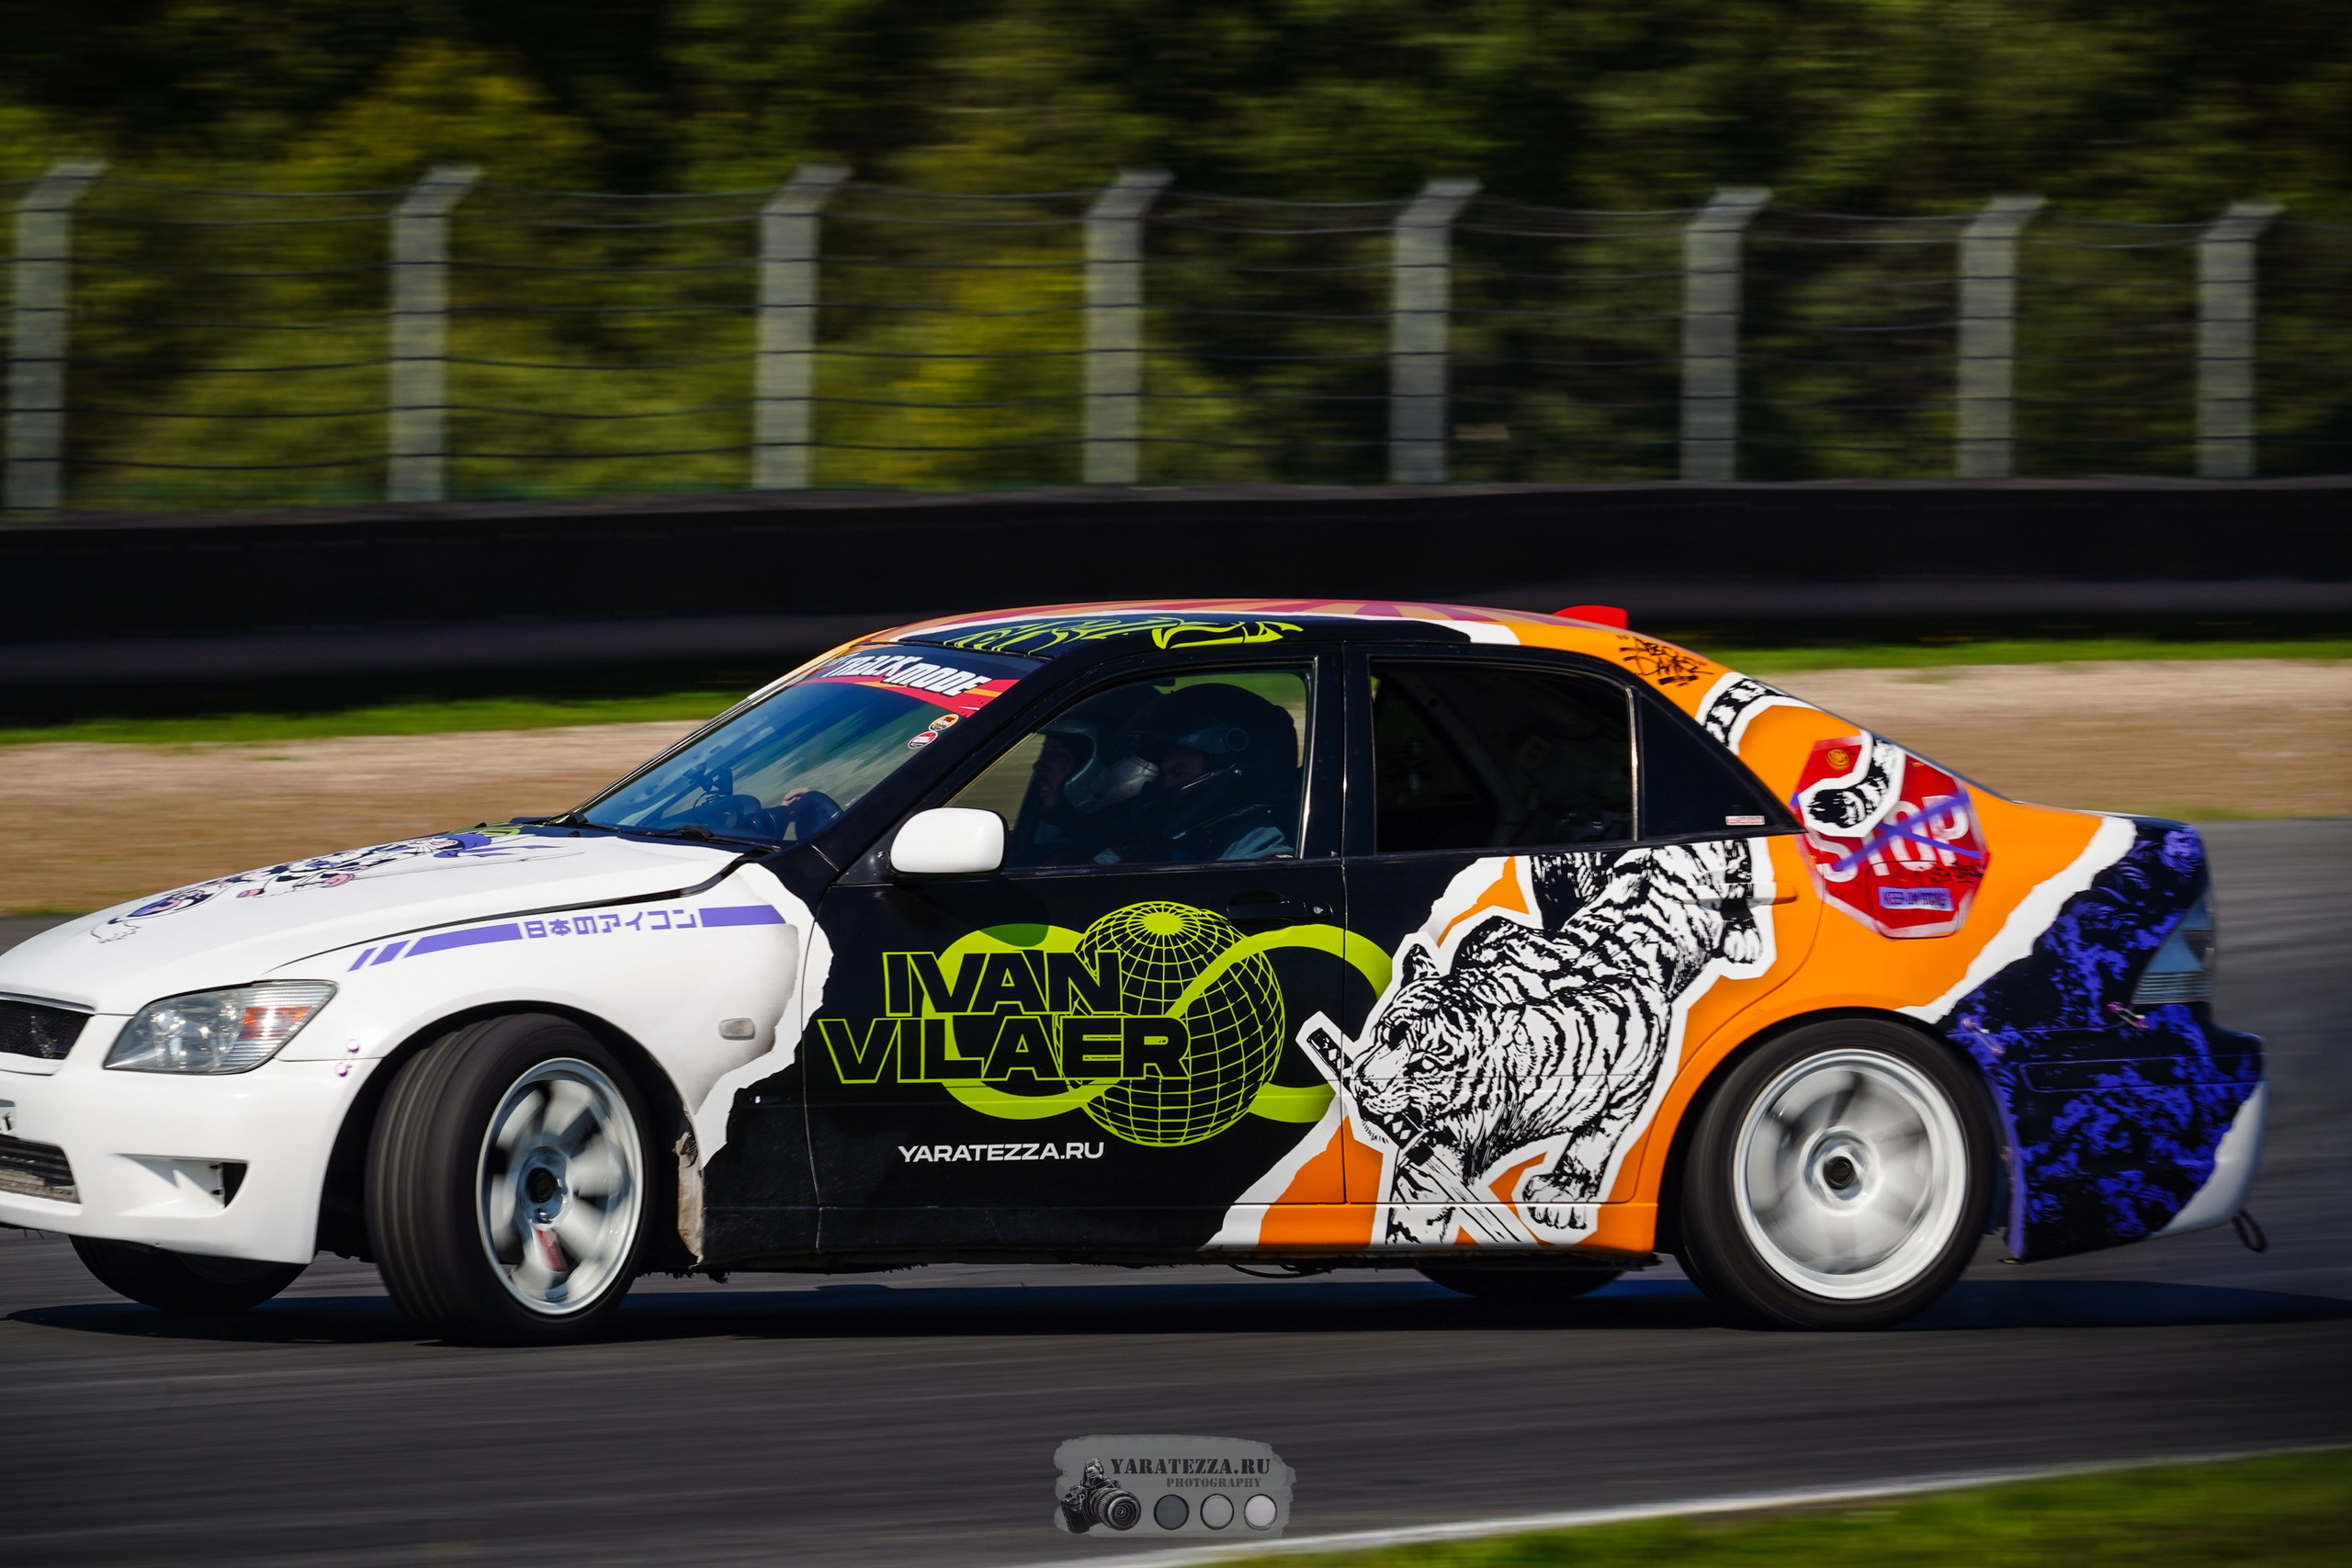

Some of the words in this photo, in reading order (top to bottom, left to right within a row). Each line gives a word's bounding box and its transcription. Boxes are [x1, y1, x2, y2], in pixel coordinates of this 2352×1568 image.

[524, 909, 696, 938] 日本のアイコン
[882, 952, 1124, 1016] IVAN
[817, 1016, 1191, 1083] VILAER
[898, 1142, 1104, 1163] YARATEZZA.RU
